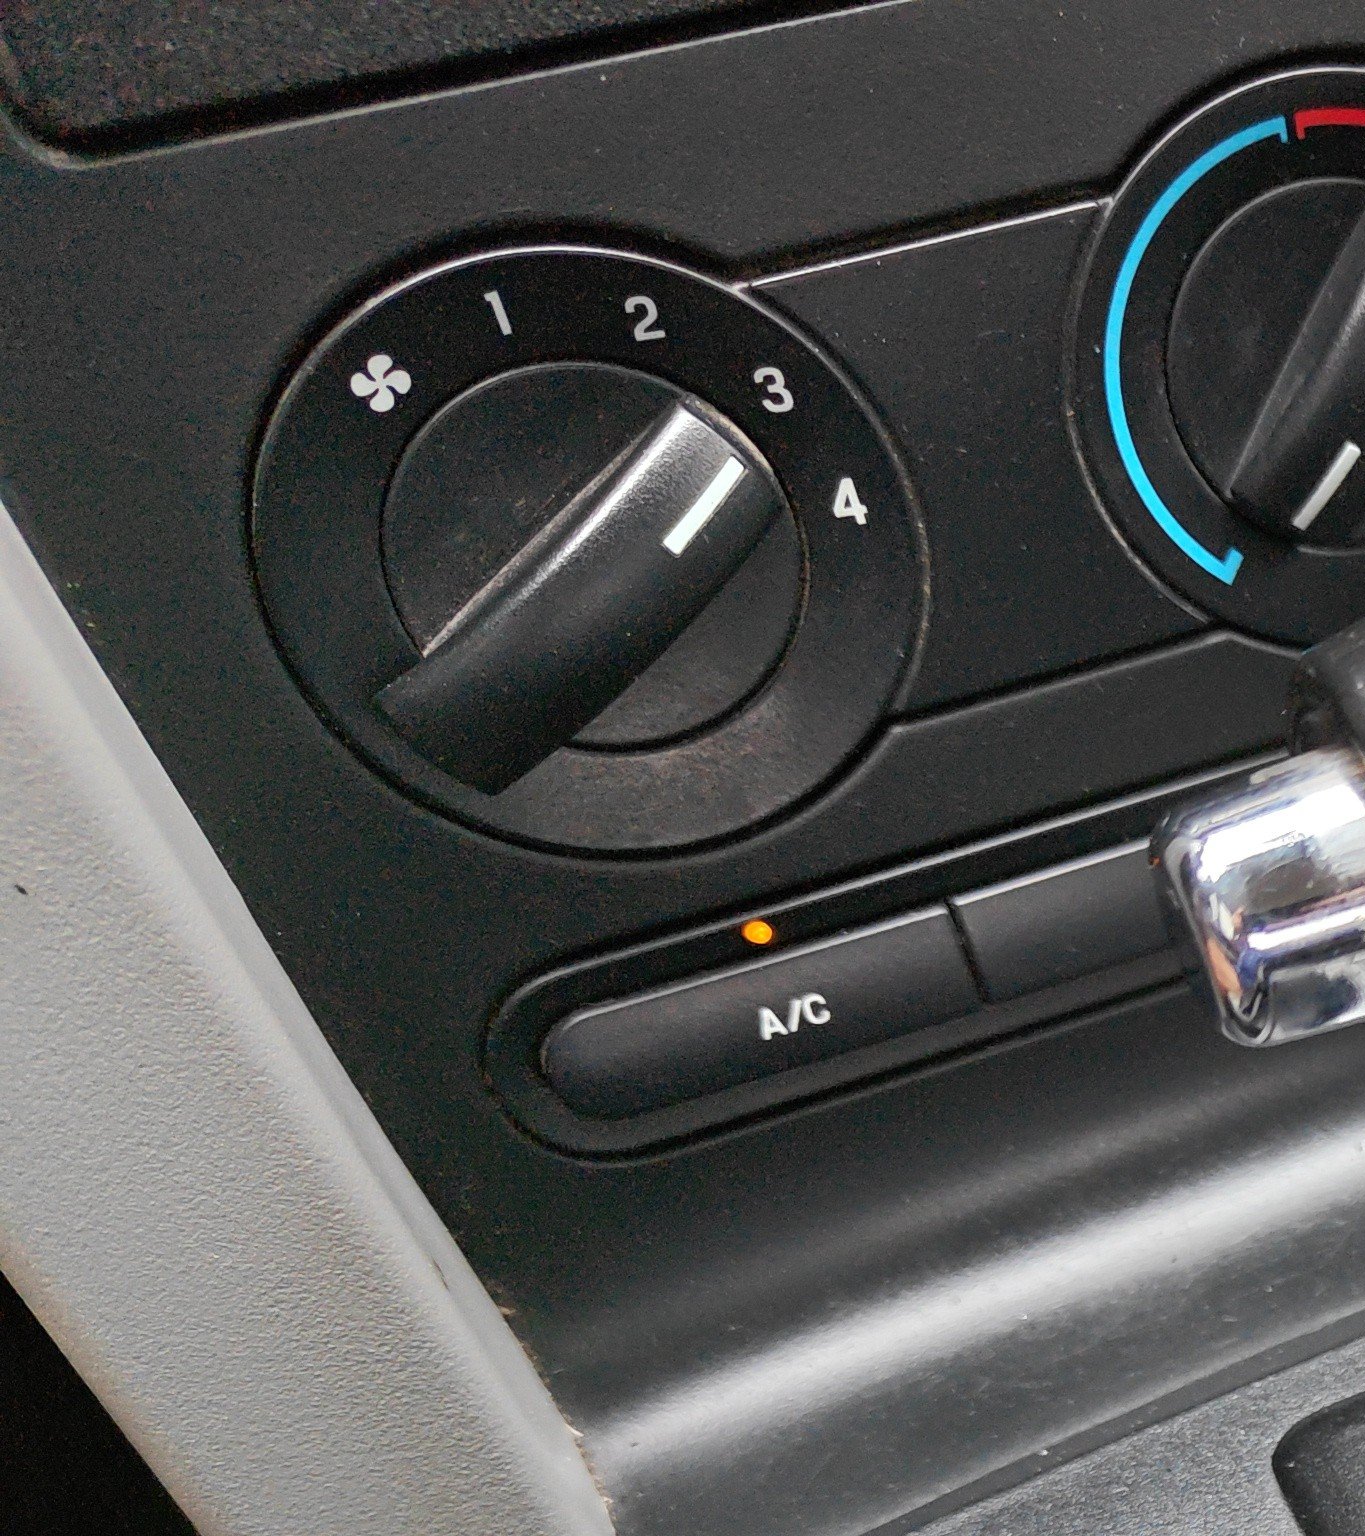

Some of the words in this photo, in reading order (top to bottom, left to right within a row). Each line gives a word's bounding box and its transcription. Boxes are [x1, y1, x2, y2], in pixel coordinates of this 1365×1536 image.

[483, 290, 513, 336] 1
[624, 295, 666, 342] 2
[753, 366, 795, 414] 3
[831, 476, 869, 526] 4
[758, 992, 832, 1041] A/C
